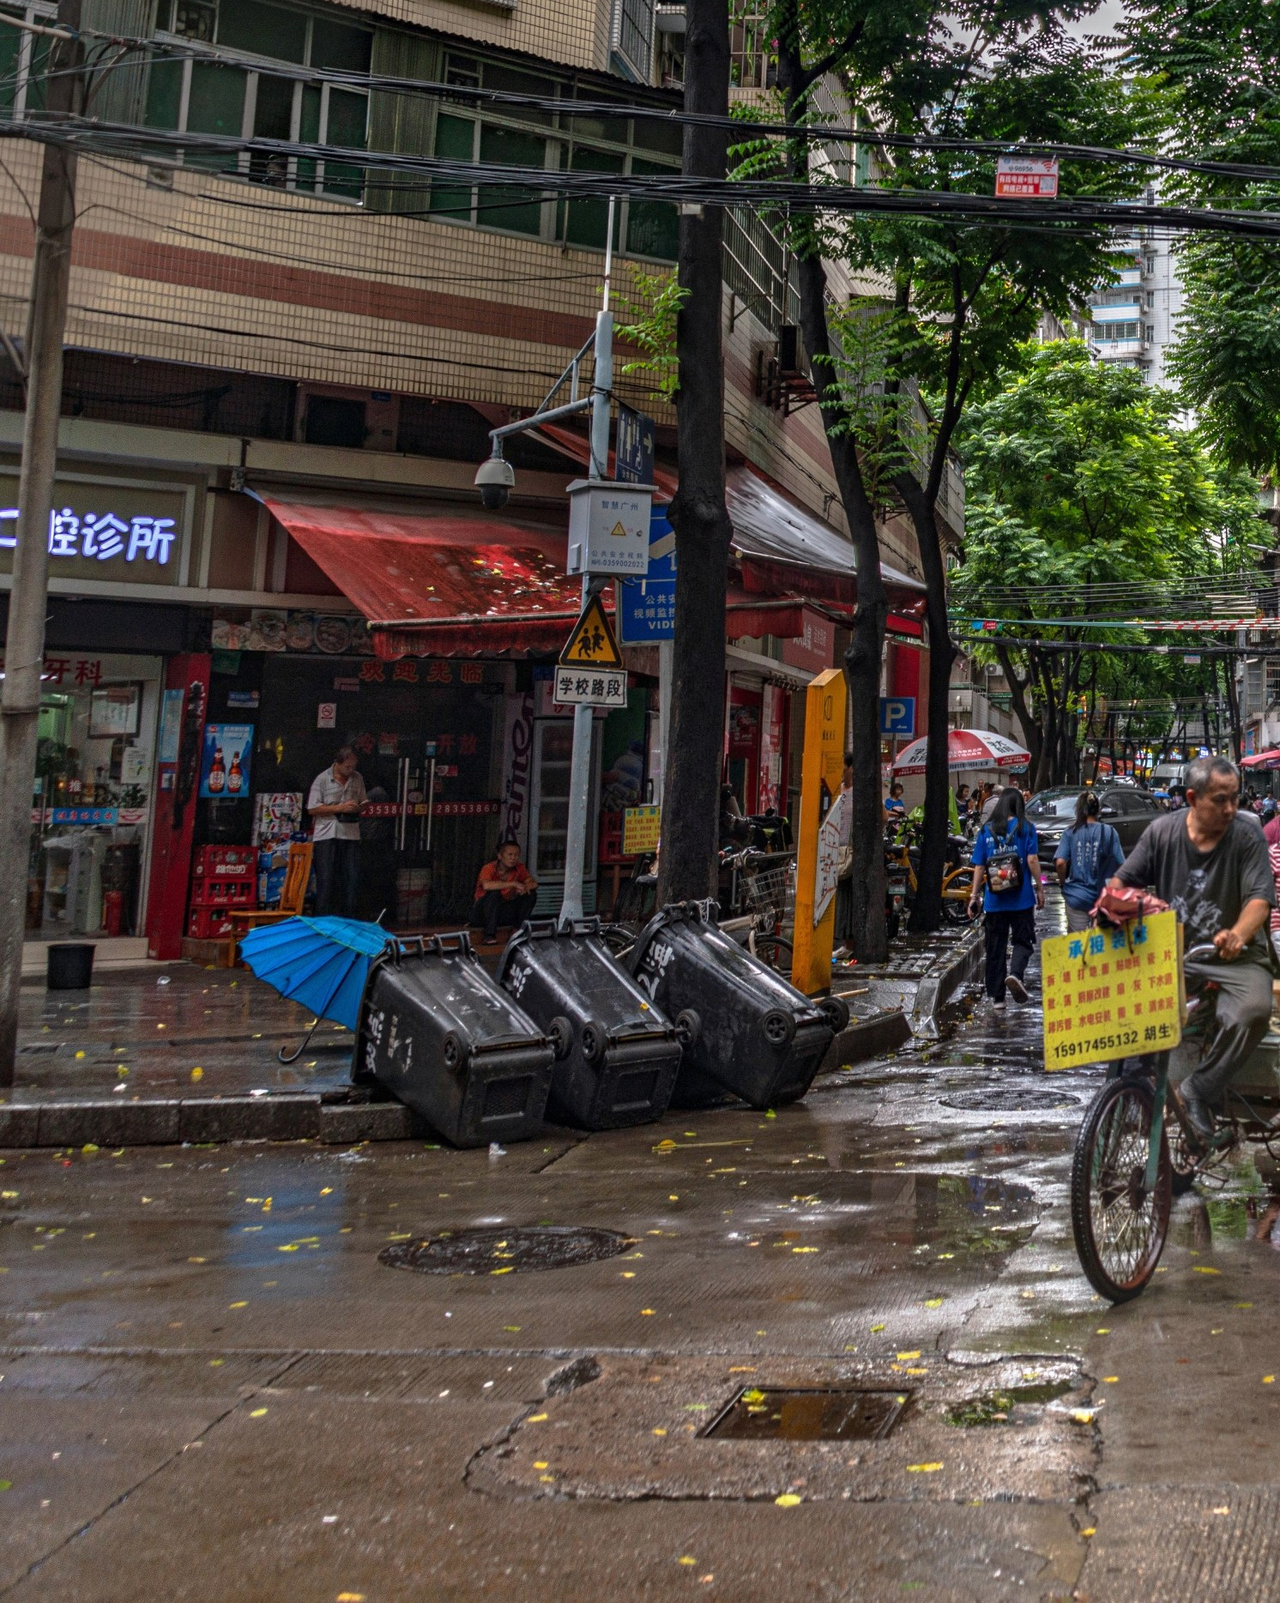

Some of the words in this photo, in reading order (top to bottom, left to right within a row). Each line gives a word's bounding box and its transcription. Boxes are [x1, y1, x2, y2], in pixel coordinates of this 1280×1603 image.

[601, 500, 639, 511] 智慧广州
[359, 660, 484, 683] 欢迎光临
[559, 677, 622, 697] 学校路段
[885, 702, 906, 729] P
[69, 779, 82, 792] 推
[436, 803, 499, 815] 28353860
[1054, 1030, 1139, 1059] 15917455132
[1144, 1022, 1171, 1042] 胡生
